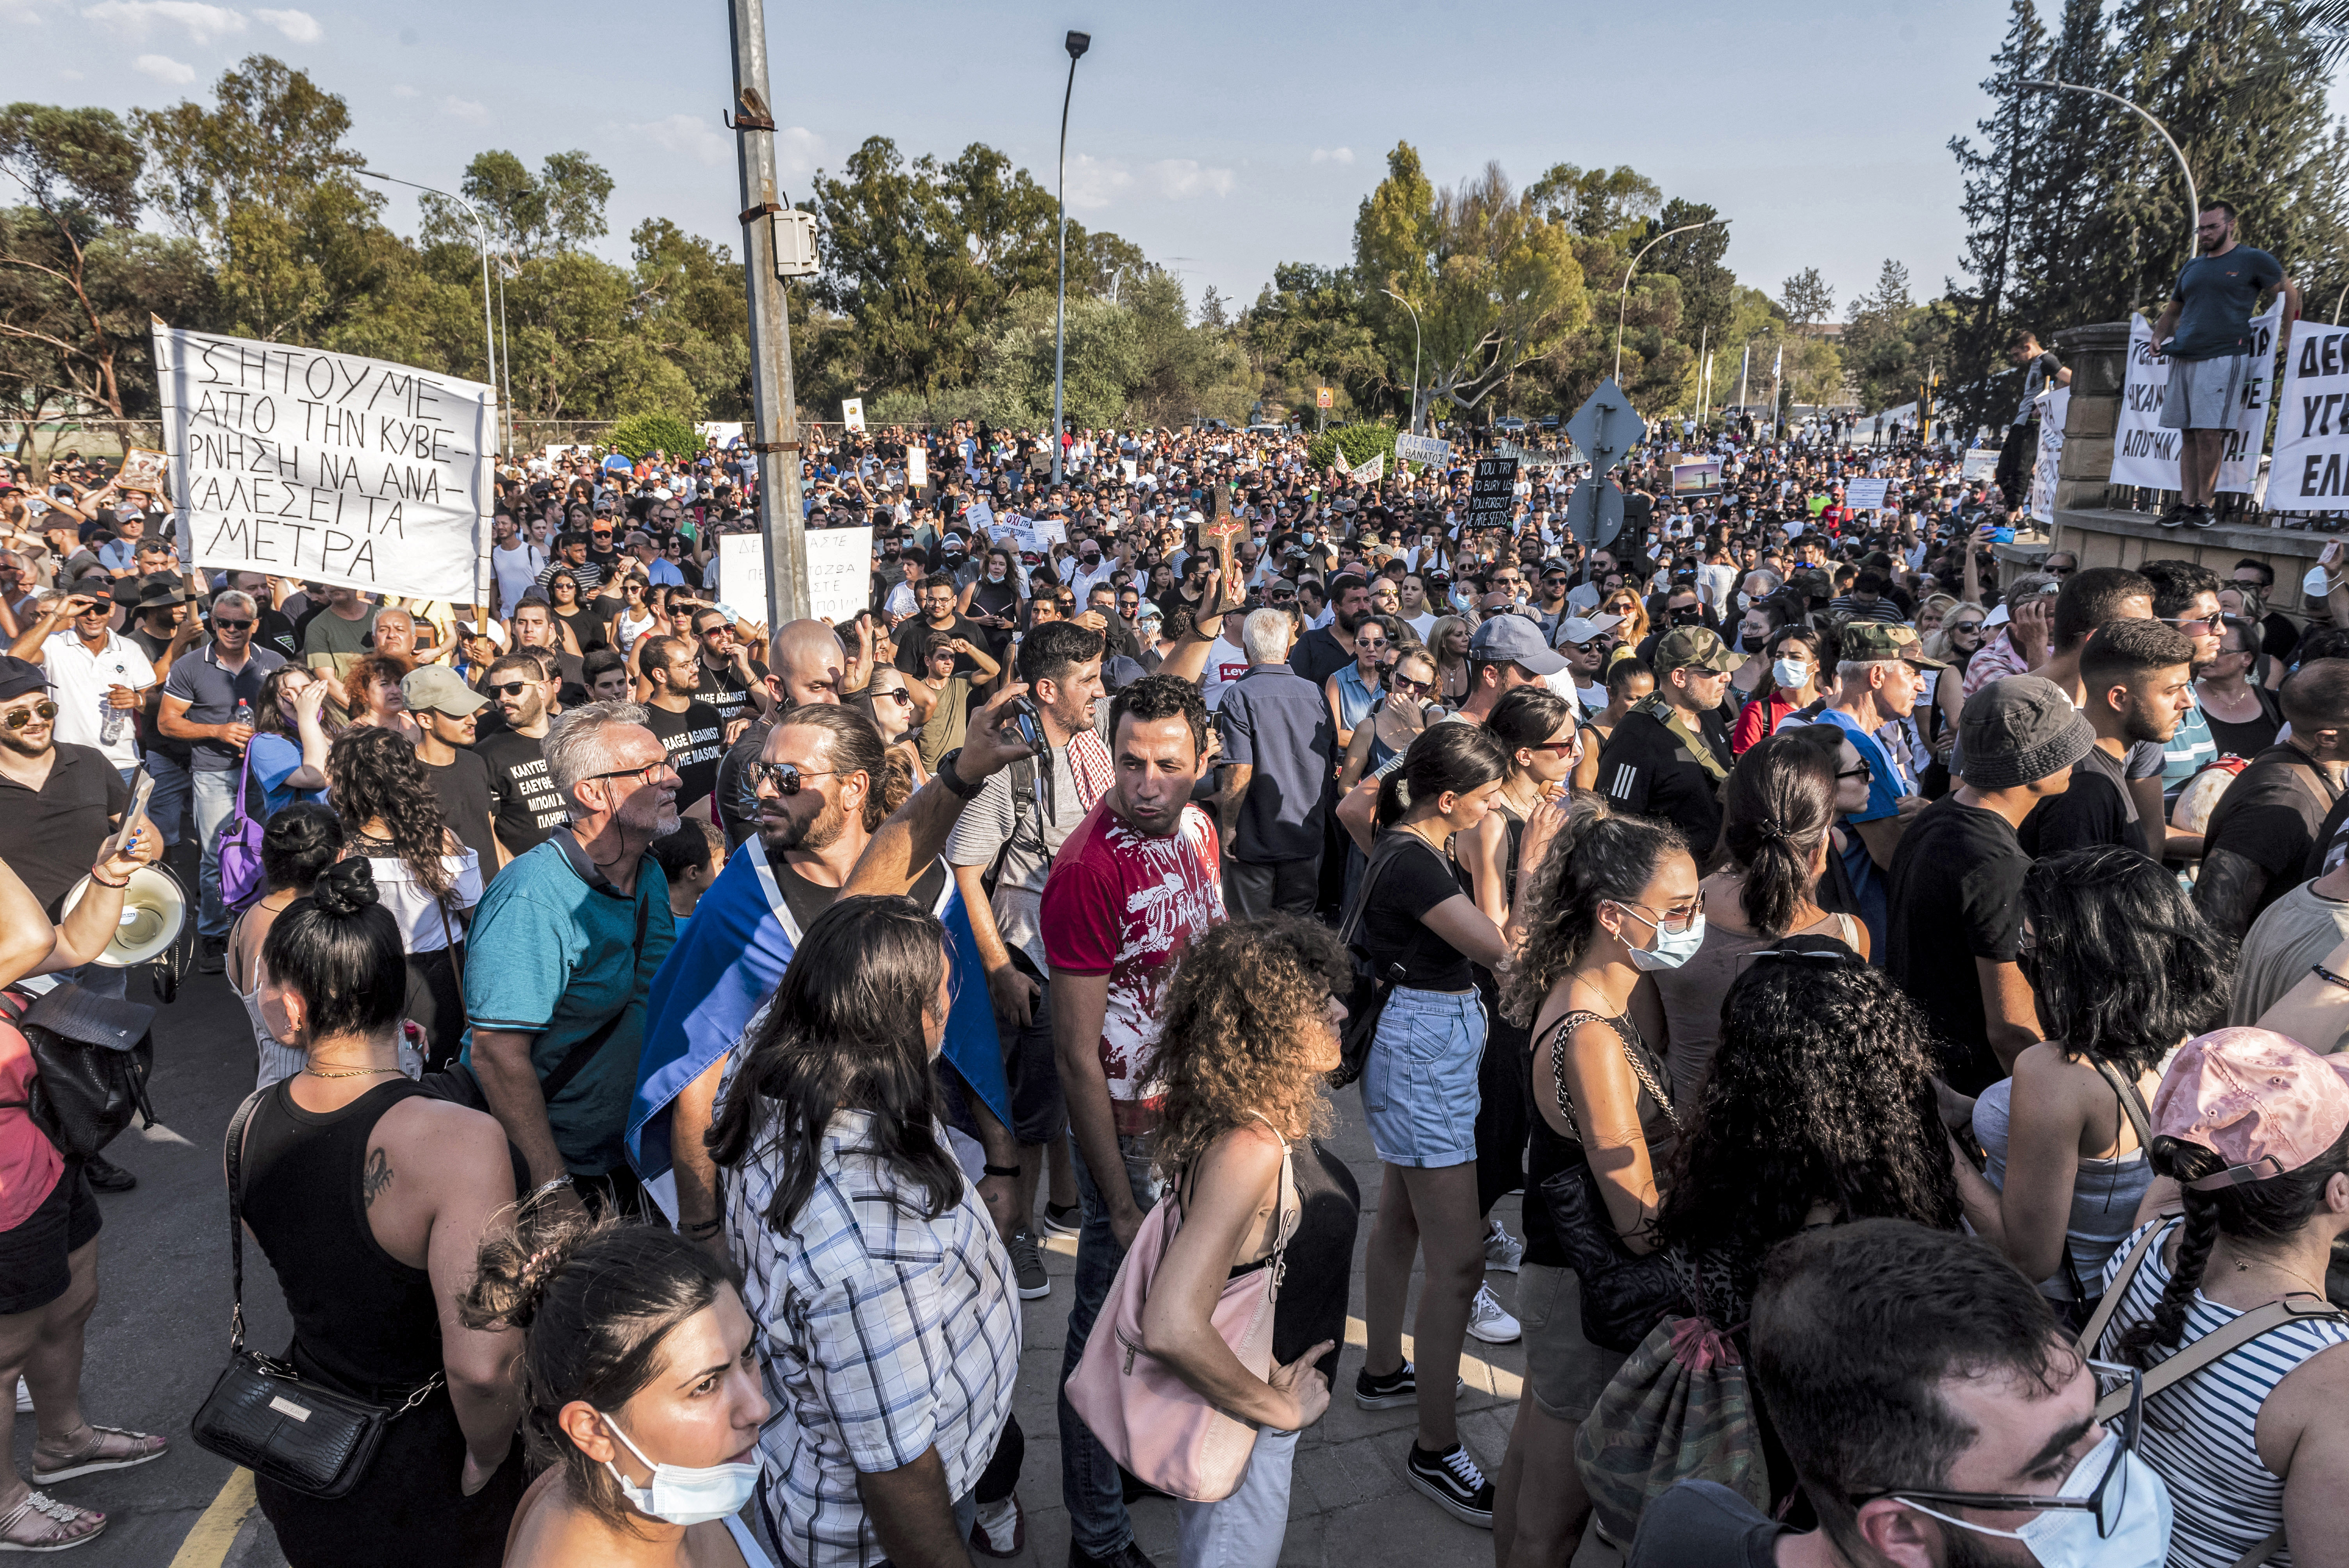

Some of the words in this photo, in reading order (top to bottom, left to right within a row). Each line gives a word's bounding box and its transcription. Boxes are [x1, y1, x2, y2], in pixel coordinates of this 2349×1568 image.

[189, 390, 275, 433] ΑΠΟ
[298, 399, 364, 448] ΤΗΝ
[1400, 435, 1448, 453] ΕΛΕΥΘΕΡΙΑ
[189, 434, 298, 479] ΡΝΗΣΗ
[321, 452, 363, 493] ΝΑ
[1405, 448, 1444, 464] ΘΑΝΑΤΟΣ
[1547, 446, 1574, 465] SLAVE
[1575, 444, 1588, 462] PA
[1481, 462, 1496, 476] YOU
[1499, 461, 1513, 474] TRY
[1474, 480, 1482, 491] TO
[1484, 480, 1501, 491] BURY
[1503, 479, 1513, 491] US
[189, 476, 343, 524] ΚΑΛΕΣΕΙ
[360, 495, 403, 539] ΤΑ
[1472, 496, 1485, 510] YOU
[1485, 496, 1510, 508] FORGOT
[1006, 515, 1021, 526] ΟΧΙ
[1019, 520, 1030, 529] ΣΤΗ
[1466, 513, 1475, 526] WE
[1474, 512, 1489, 526] ARE
[1488, 510, 1509, 526] SEEDS
[1001, 526, 1027, 538] ΔΙΚΤΑΤΟΡΙΑ
[205, 517, 375, 582] ΜΕΤΡΑ
[740, 539, 759, 554] ΔΕ
[806, 535, 847, 549] ΑΣΤΕ
[716, 690, 747, 704] AGAINST
[661, 733, 690, 752] RAGE
[687, 727, 720, 745] AGAINST
[510, 759, 548, 779] ΚΑΛΥΤΕ
[518, 776, 555, 796] ΕΛΕΥΘΕ
[536, 810, 569, 829] ΠΛΗΡΗ
[277, 1402, 289, 1410] RIVER
